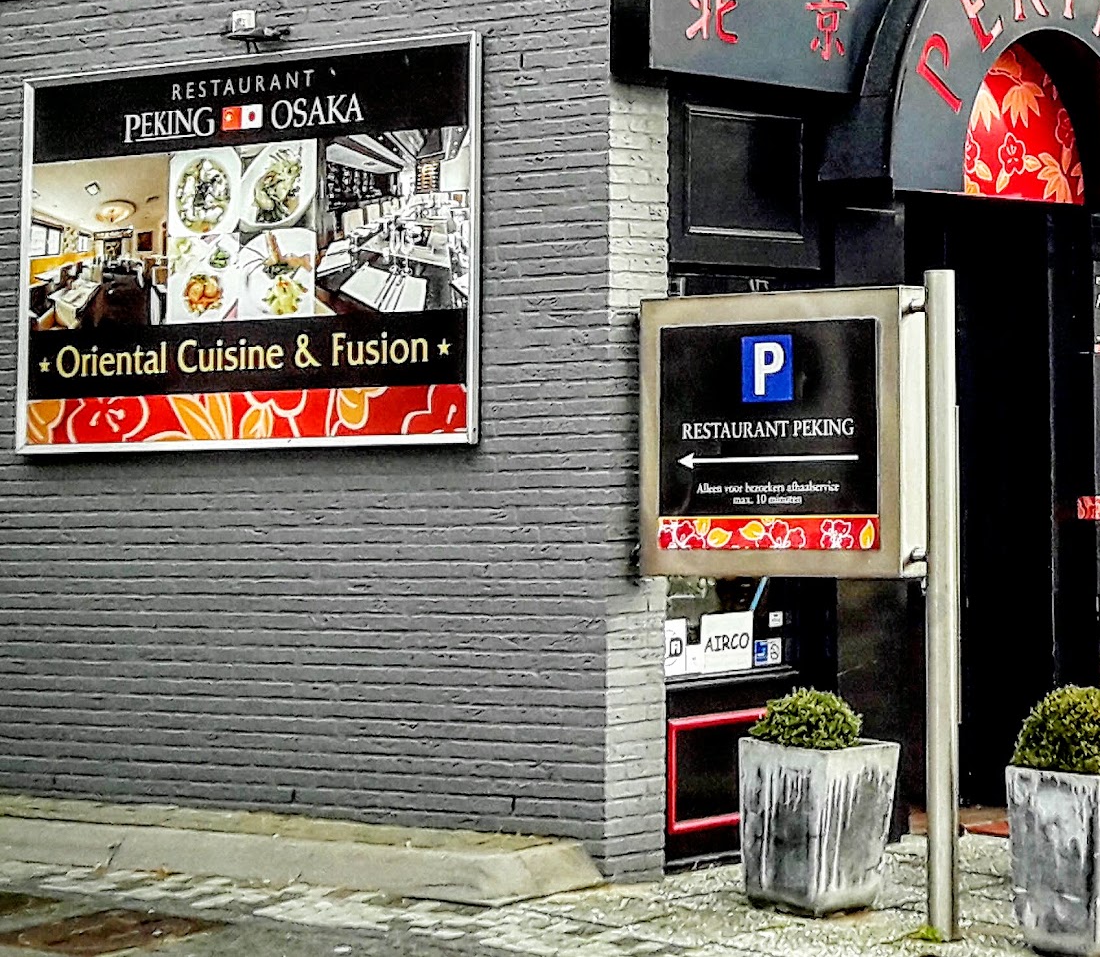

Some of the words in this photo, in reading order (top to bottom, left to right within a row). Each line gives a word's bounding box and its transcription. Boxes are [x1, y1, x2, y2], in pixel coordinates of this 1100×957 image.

[171, 69, 315, 101] RESTAURANT
[123, 106, 216, 143] PEKING
[270, 92, 365, 130] OSAKA
[55, 339, 168, 379] Oriental
[177, 336, 284, 374] Cuisine
[293, 332, 323, 369] &
[331, 331, 430, 367] Fusion
[753, 342, 785, 396] P
[681, 420, 790, 440] RESTAURANT
[792, 418, 855, 438] PEKING
[756, 494, 767, 505] 10
[703, 632, 751, 653] AIRCO
